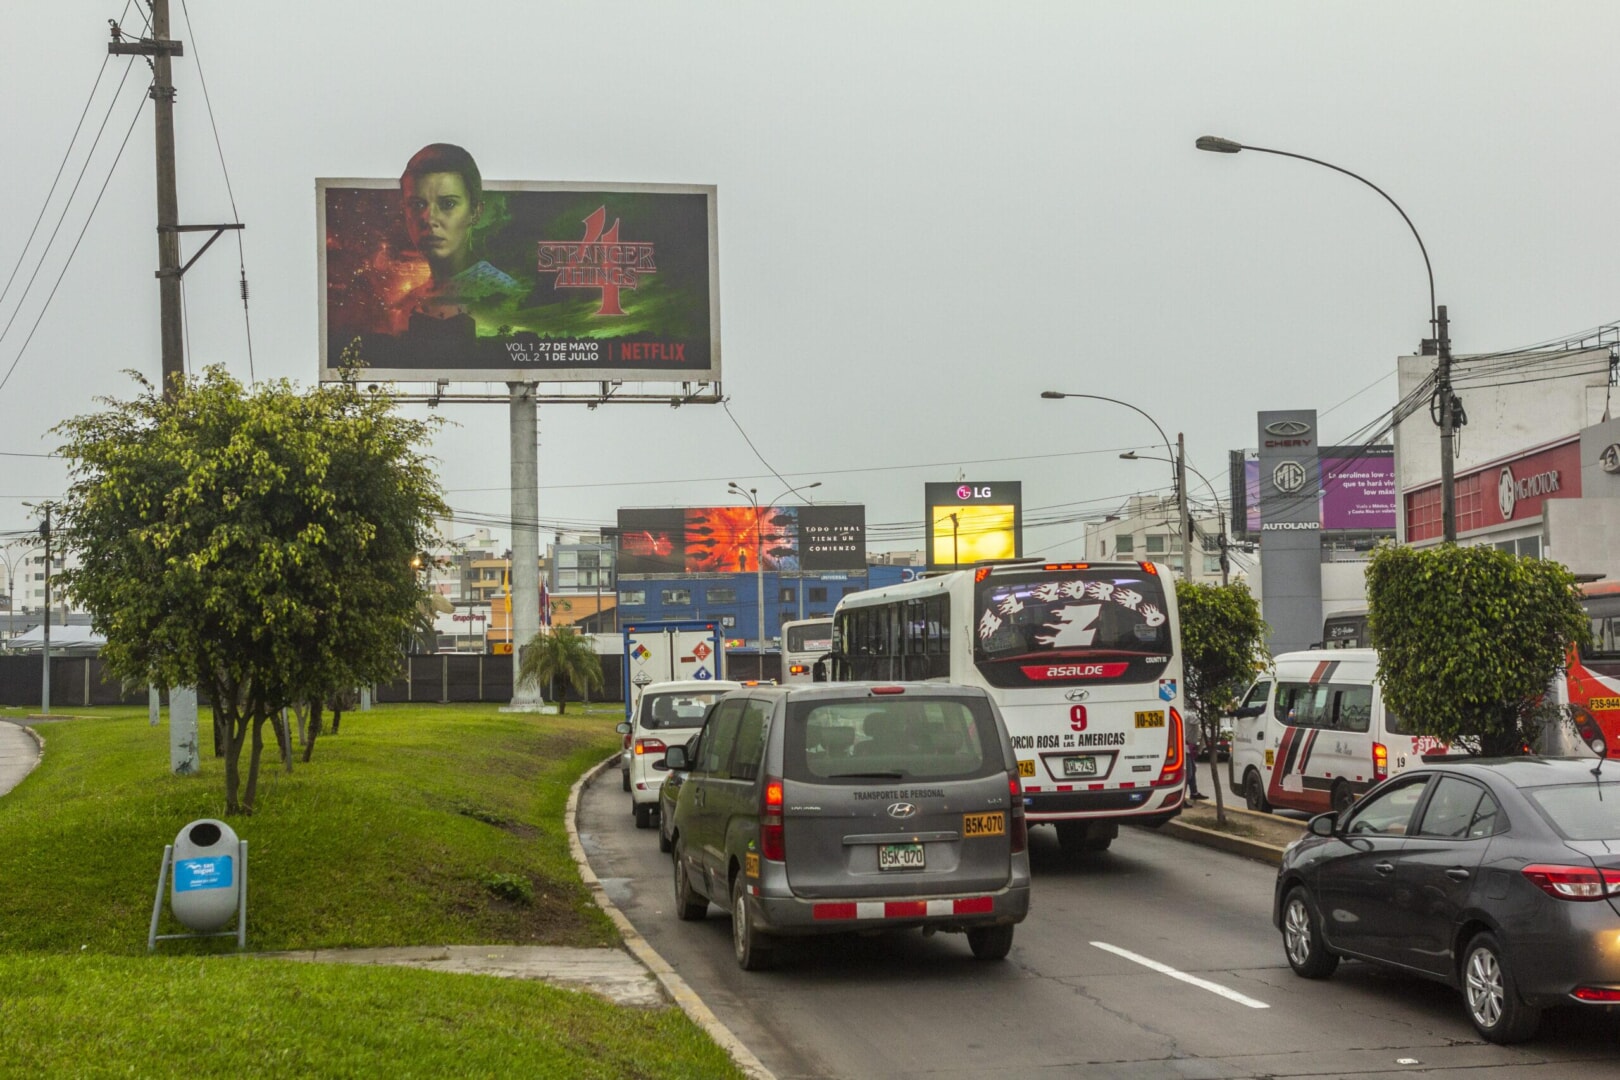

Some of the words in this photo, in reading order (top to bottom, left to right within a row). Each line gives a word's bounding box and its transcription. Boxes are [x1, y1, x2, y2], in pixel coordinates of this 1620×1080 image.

[538, 244, 656, 269] STRANGER
[558, 266, 637, 287] THINGS
[506, 343, 526, 351] VOL
[529, 343, 533, 351] 1
[539, 343, 551, 351] 27
[553, 343, 567, 351] DE
[569, 343, 599, 351] MAYO
[621, 343, 686, 361] NETFLIX
[511, 353, 532, 361] VOL
[533, 353, 540, 361] 2
[544, 353, 549, 361] 1
[552, 353, 566, 361] DE
[568, 353, 599, 361] JULIO
[1264, 439, 1312, 448] CHERY
[974, 486, 992, 498] LG
[1515, 478, 1528, 501] MG
[1527, 470, 1560, 498] MOTOR
[1262, 522, 1320, 531] AUTOLAND
[1034, 604, 1102, 648] Z
[1590, 698, 1620, 708] F3S-944
[1070, 704, 1087, 731] 9
[1010, 735, 1034, 749] ORCIO
[1037, 735, 1060, 749] ROSA
[1078, 732, 1126, 747] AMERICAS
[1397, 757, 1406, 768] 19
[853, 790, 898, 800] TRANSPORTE
[900, 790, 909, 799] DE
[910, 789, 945, 798] PERSONAL
[965, 815, 1003, 833] B5K-070
[881, 850, 923, 864] B5K-070
